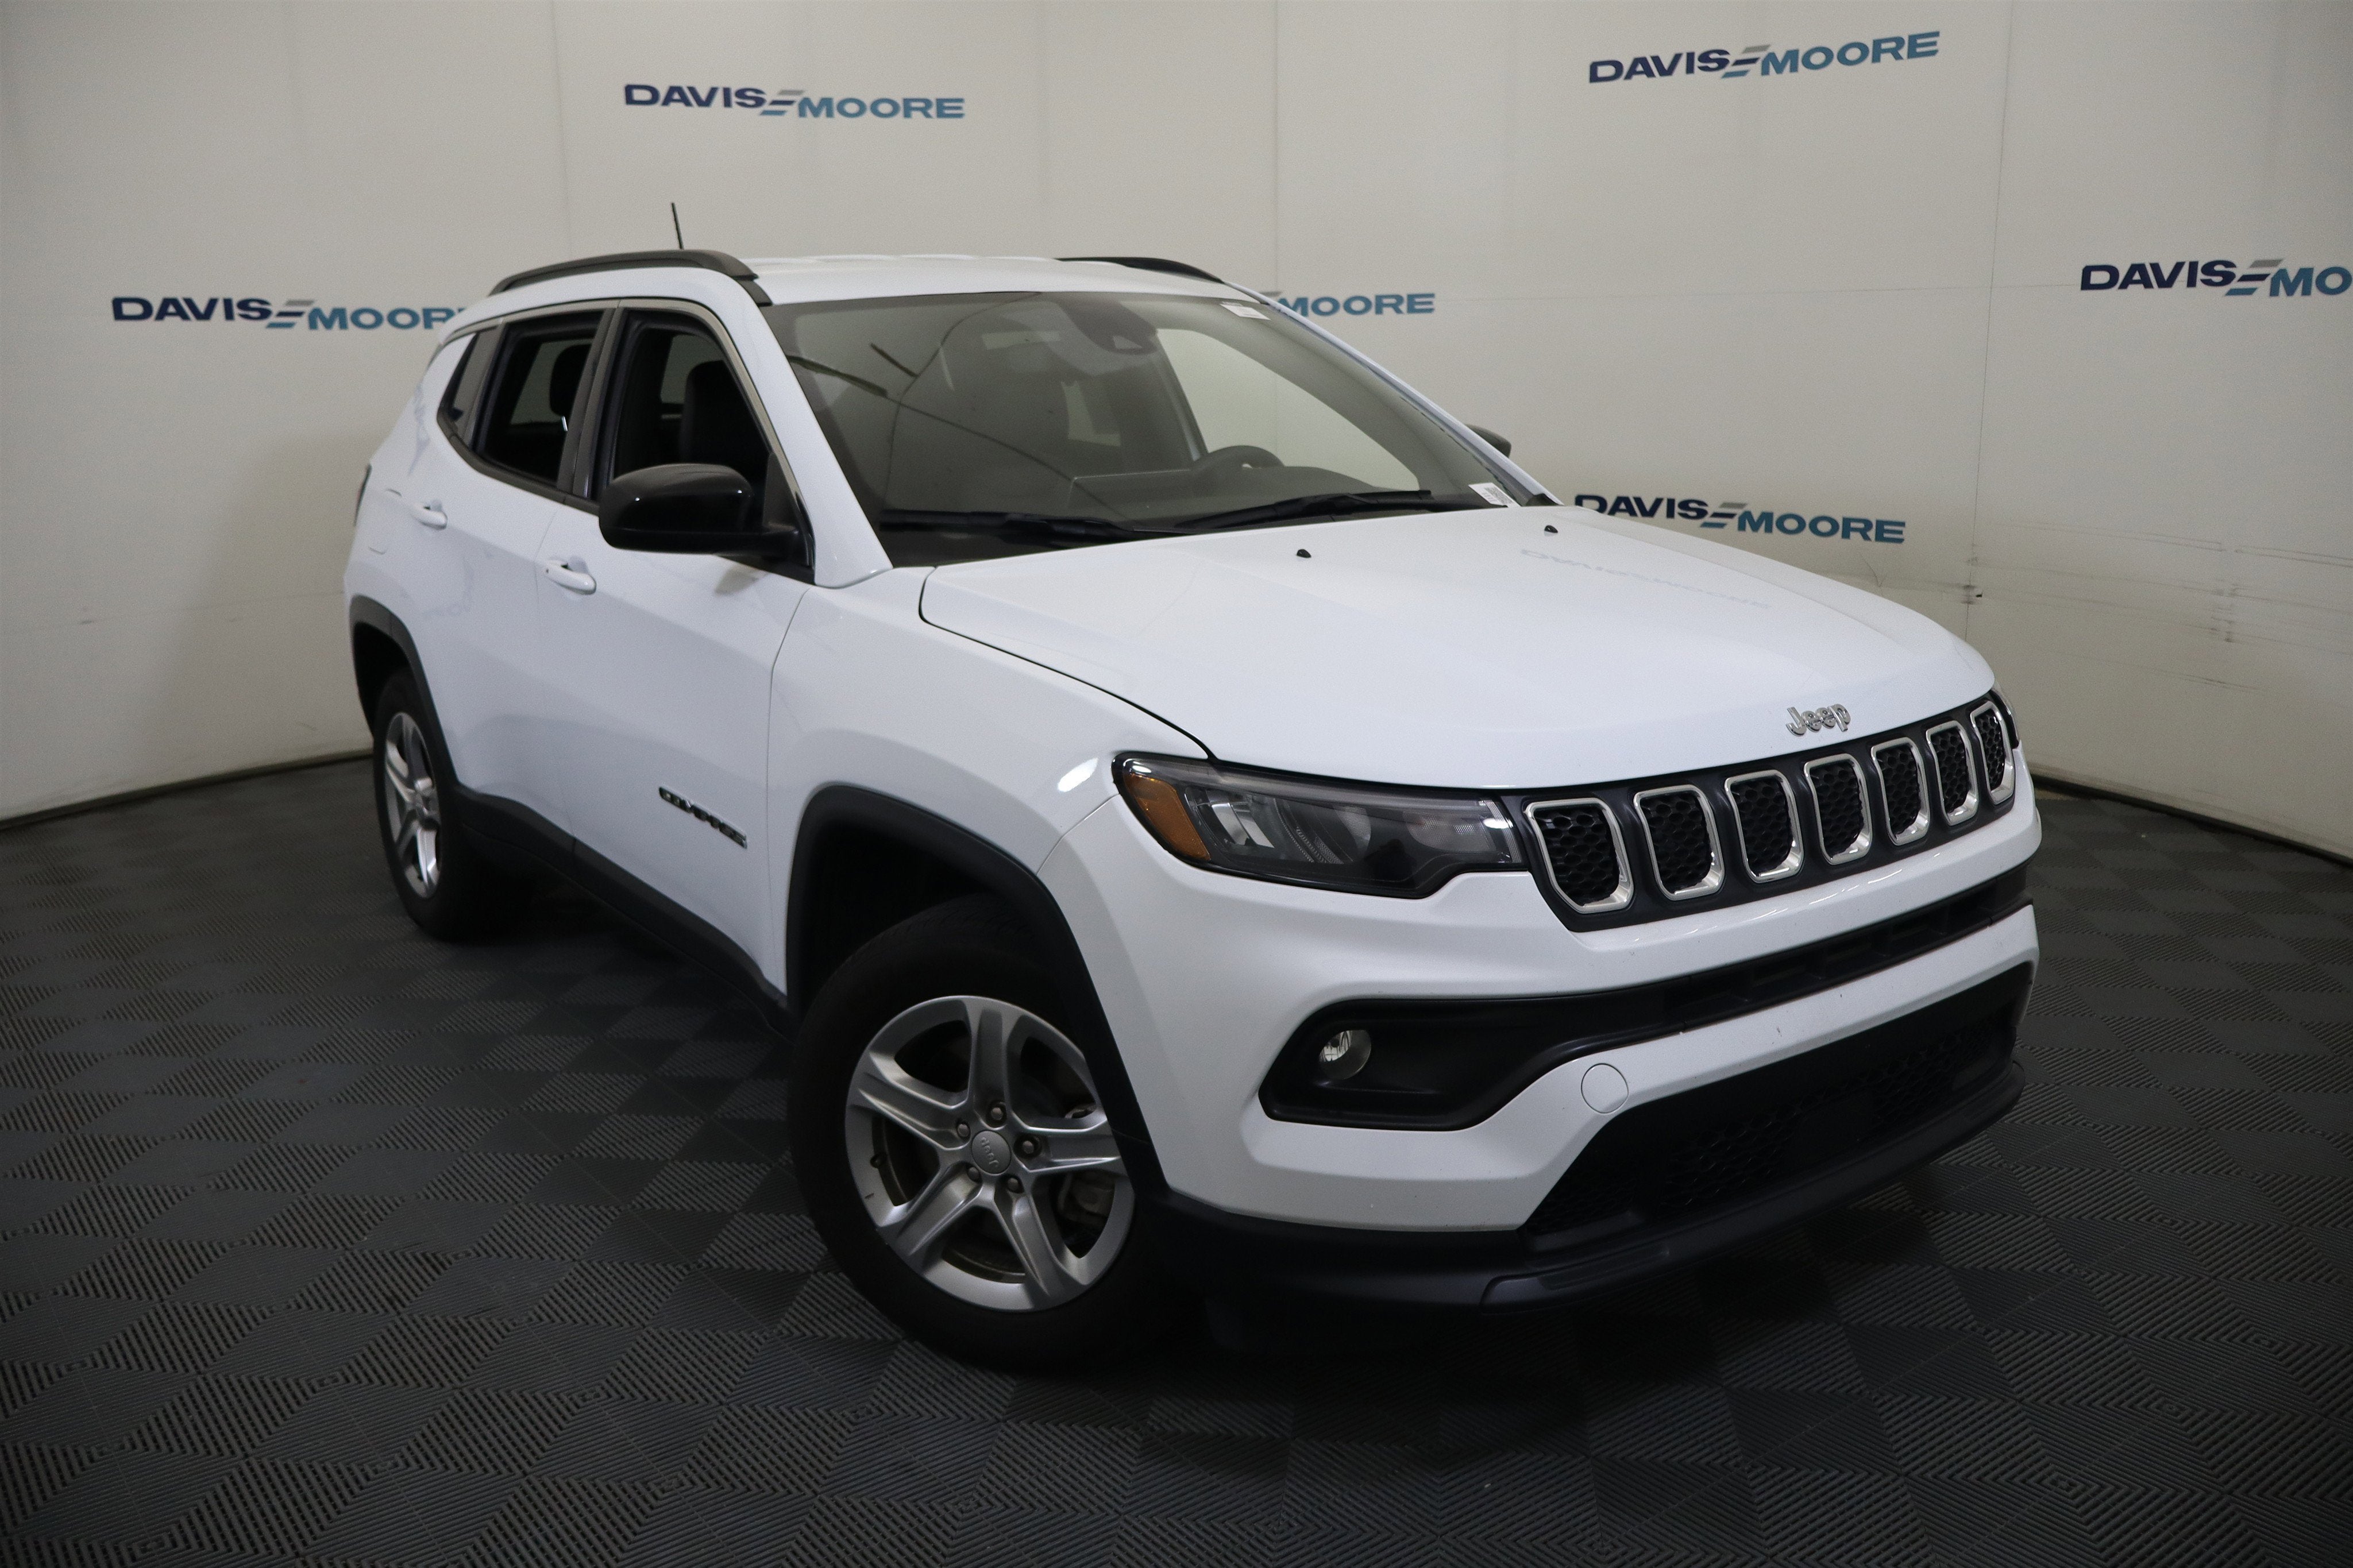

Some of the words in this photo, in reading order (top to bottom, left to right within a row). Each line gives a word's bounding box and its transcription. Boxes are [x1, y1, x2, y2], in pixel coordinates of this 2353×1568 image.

[1589, 49, 1730, 83] DAVIS
[1761, 31, 1940, 76] MOORE
[624, 84, 766, 109] DAVIS
[798, 97, 965, 118] MOORE
[2080, 260, 2237, 291] DAVIS
[111, 297, 272, 321] DAVIS
[308, 307, 466, 330] MOOR
[1575, 495, 1709, 520] DAVIS
[1737, 510, 1906, 544] MOORE
[1785, 704, 1851, 737] Jeep
[980, 1137, 1000, 1167] Jeep
